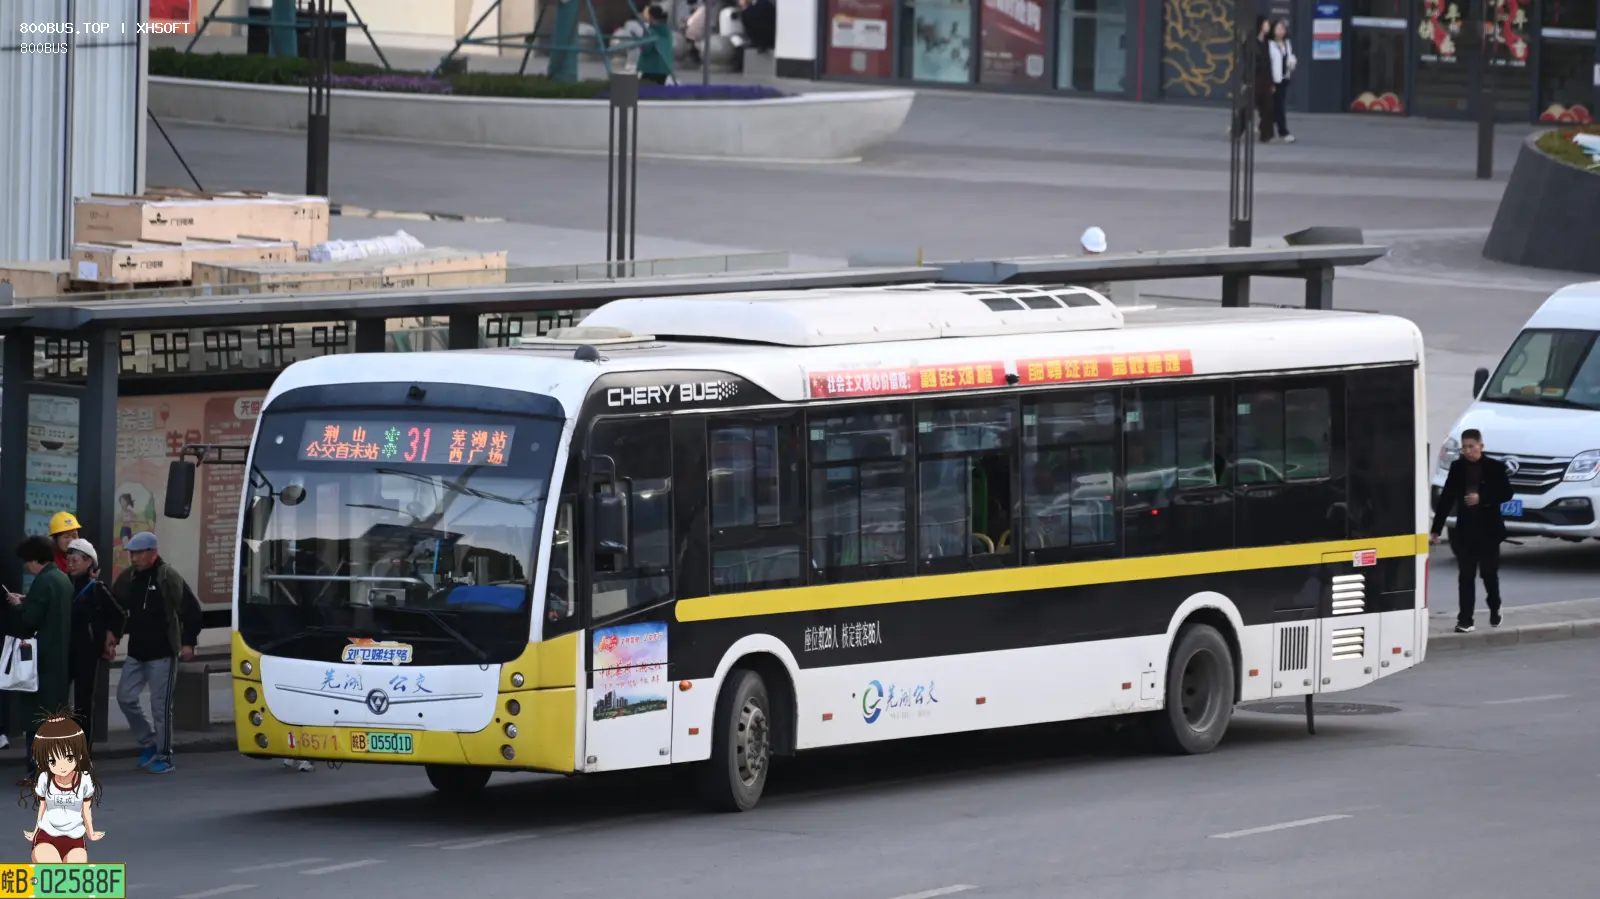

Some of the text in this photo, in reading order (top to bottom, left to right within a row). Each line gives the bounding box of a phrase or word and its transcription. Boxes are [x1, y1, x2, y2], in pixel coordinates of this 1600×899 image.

[607, 381, 719, 407] CHERY BUS
[306, 441, 380, 460] 公交首末站
[404, 427, 432, 462] 31
[450, 429, 508, 449] 芜湖站
[448, 447, 504, 465] 西广场
[804, 620, 883, 652] 座位数28人 核定载客86人
